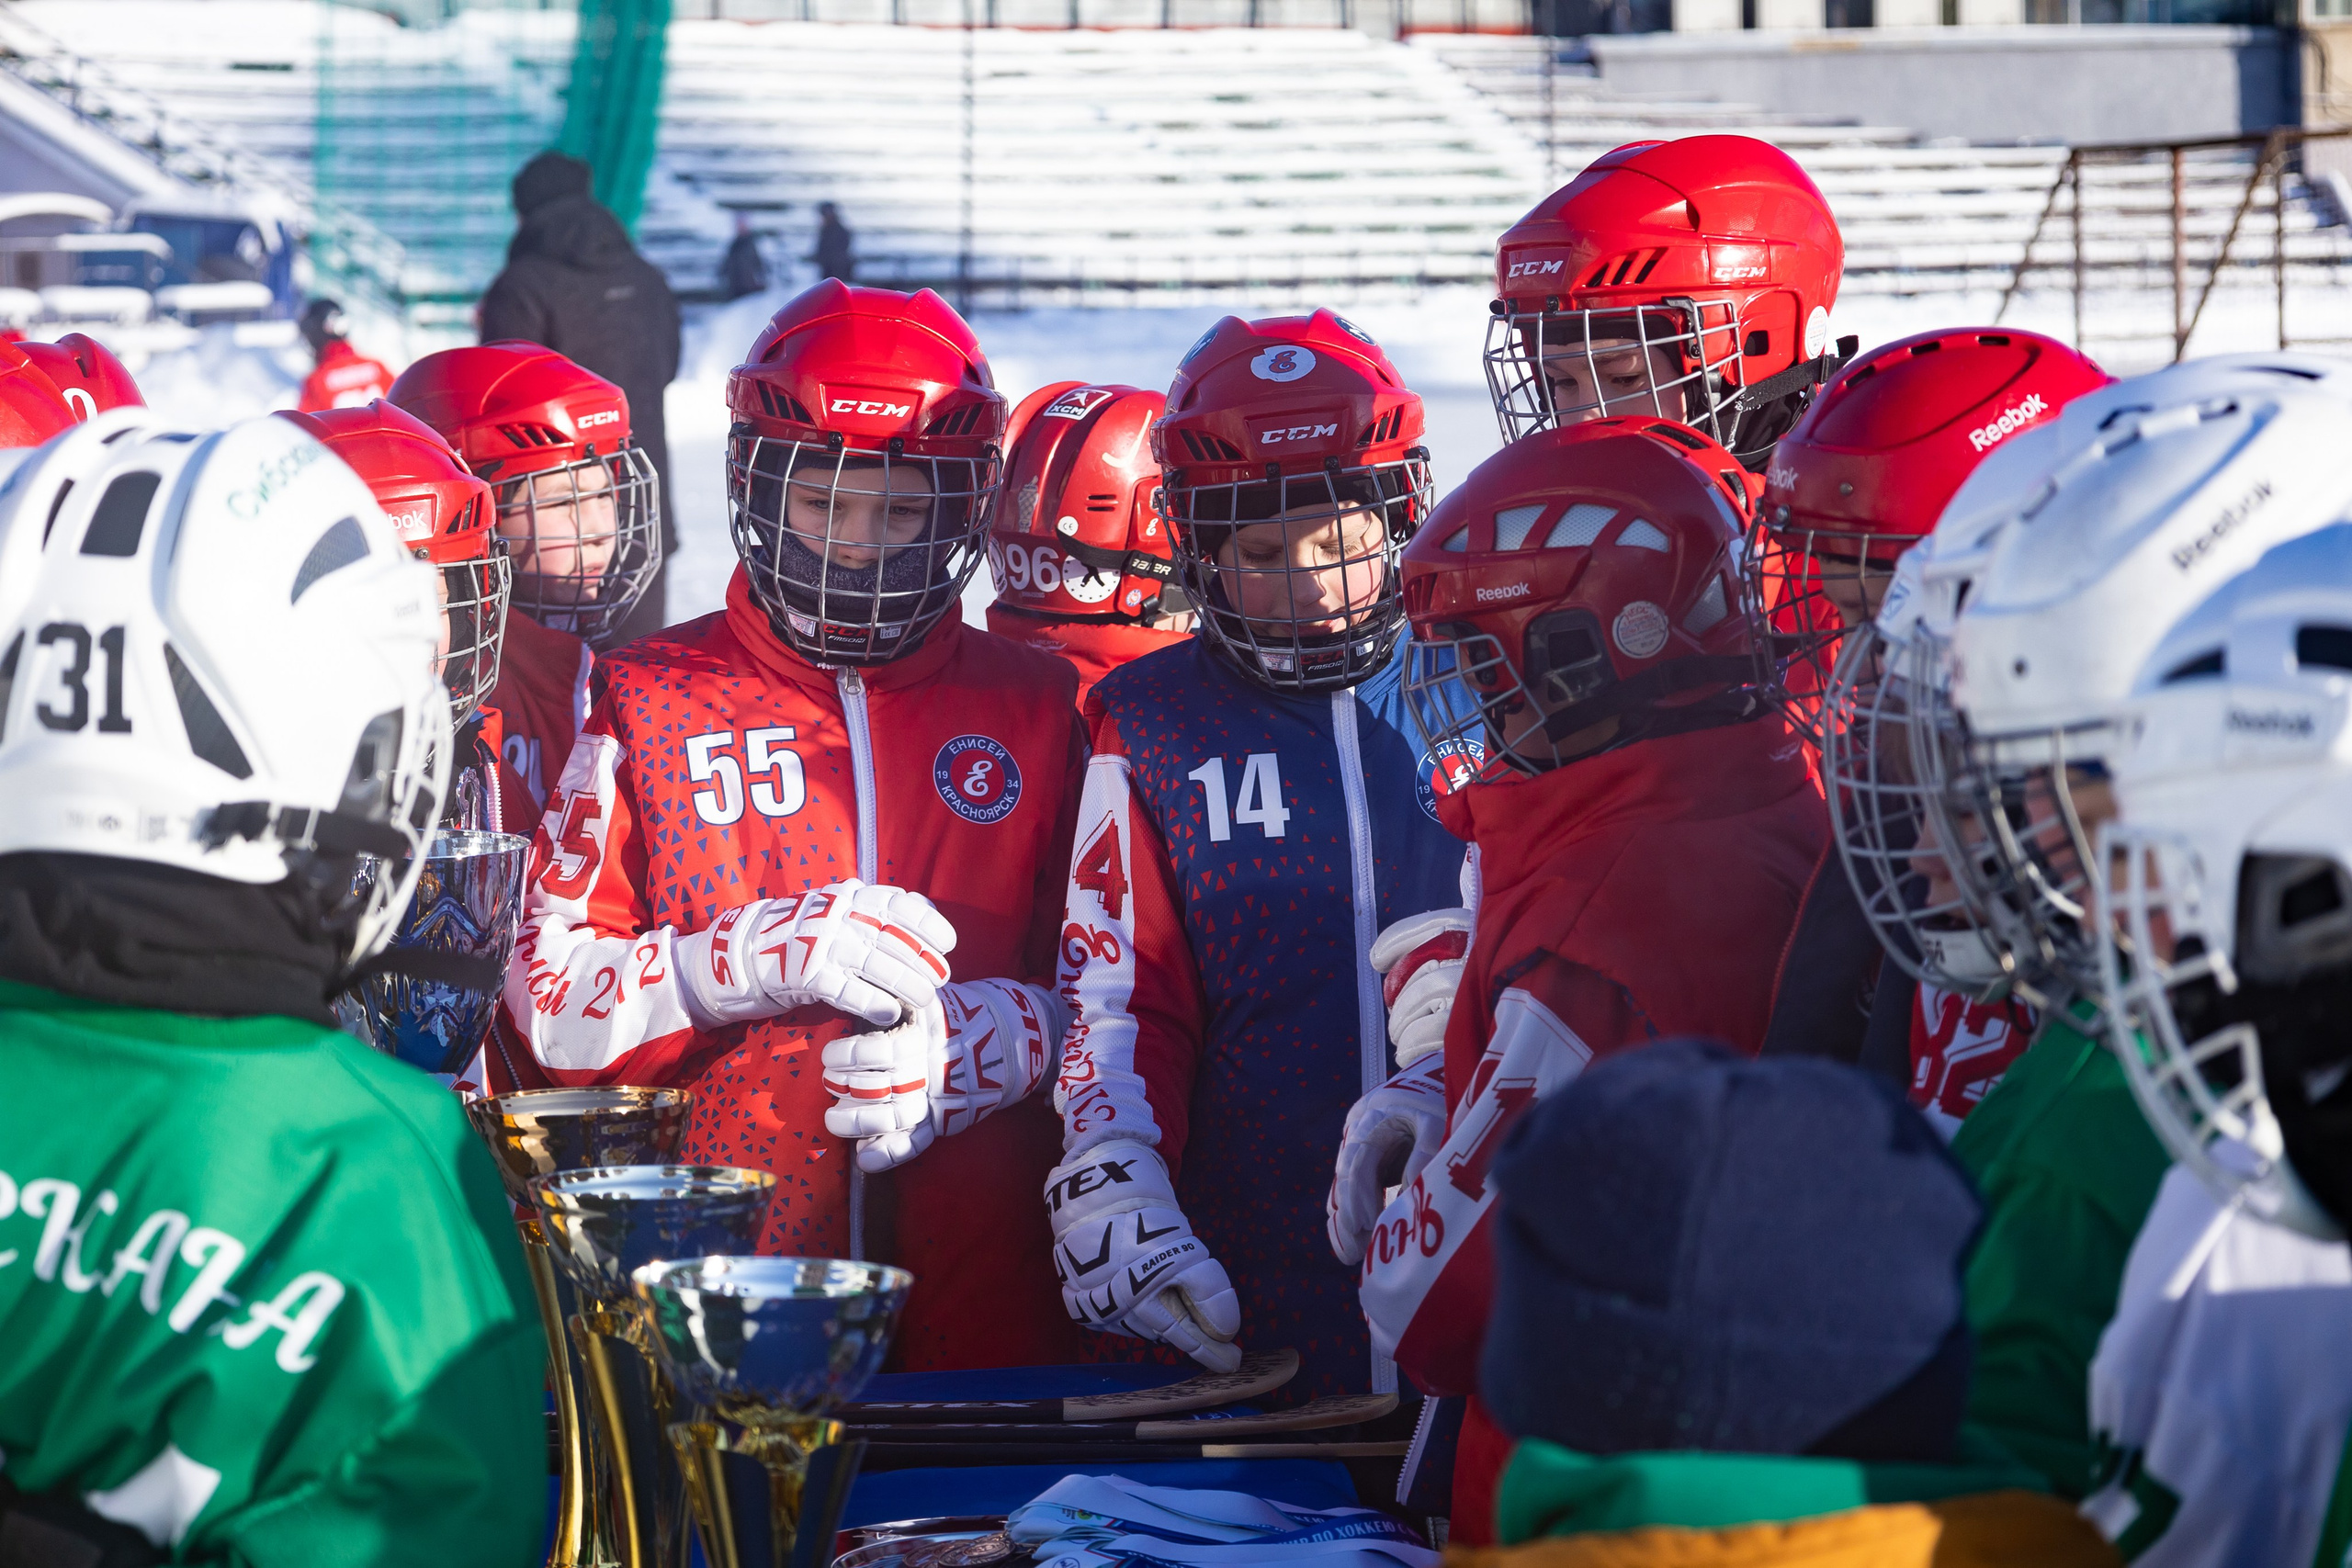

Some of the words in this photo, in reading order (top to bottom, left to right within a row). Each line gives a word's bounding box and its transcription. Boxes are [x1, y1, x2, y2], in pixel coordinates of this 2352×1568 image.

[1509, 260, 1563, 277] CCM
[1714, 266, 1765, 278] CCM
[577, 410, 620, 429] CCM
[831, 399, 910, 419] CCM
[1969, 393, 2048, 452] Reebok
[1261, 423, 1338, 444] CCM
[390, 511, 427, 530] bok
[1006, 543, 1061, 592] 96
[1476, 581, 1531, 602] Reebok
[37, 622, 132, 733] 31
[949, 739, 1006, 761] ЕНИСЕЙ
[684, 725, 808, 826] 55
[936, 770, 949, 780] 19
[1007, 779, 1019, 789] 34
[1188, 752, 1291, 842] 14
[1418, 784, 1430, 795] 19
[942, 785, 1015, 820] КРАСНОЯРСК
[1408, 1079, 1445, 1097] RAIDE
[1045, 1159, 1138, 1220] TEX
[1141, 1247, 1181, 1274] RAIDER
[1182, 1243, 1196, 1253] 90
[1311, 1530, 1332, 1543] ПО
[1335, 1519, 1396, 1540] ХОККЕЮ
